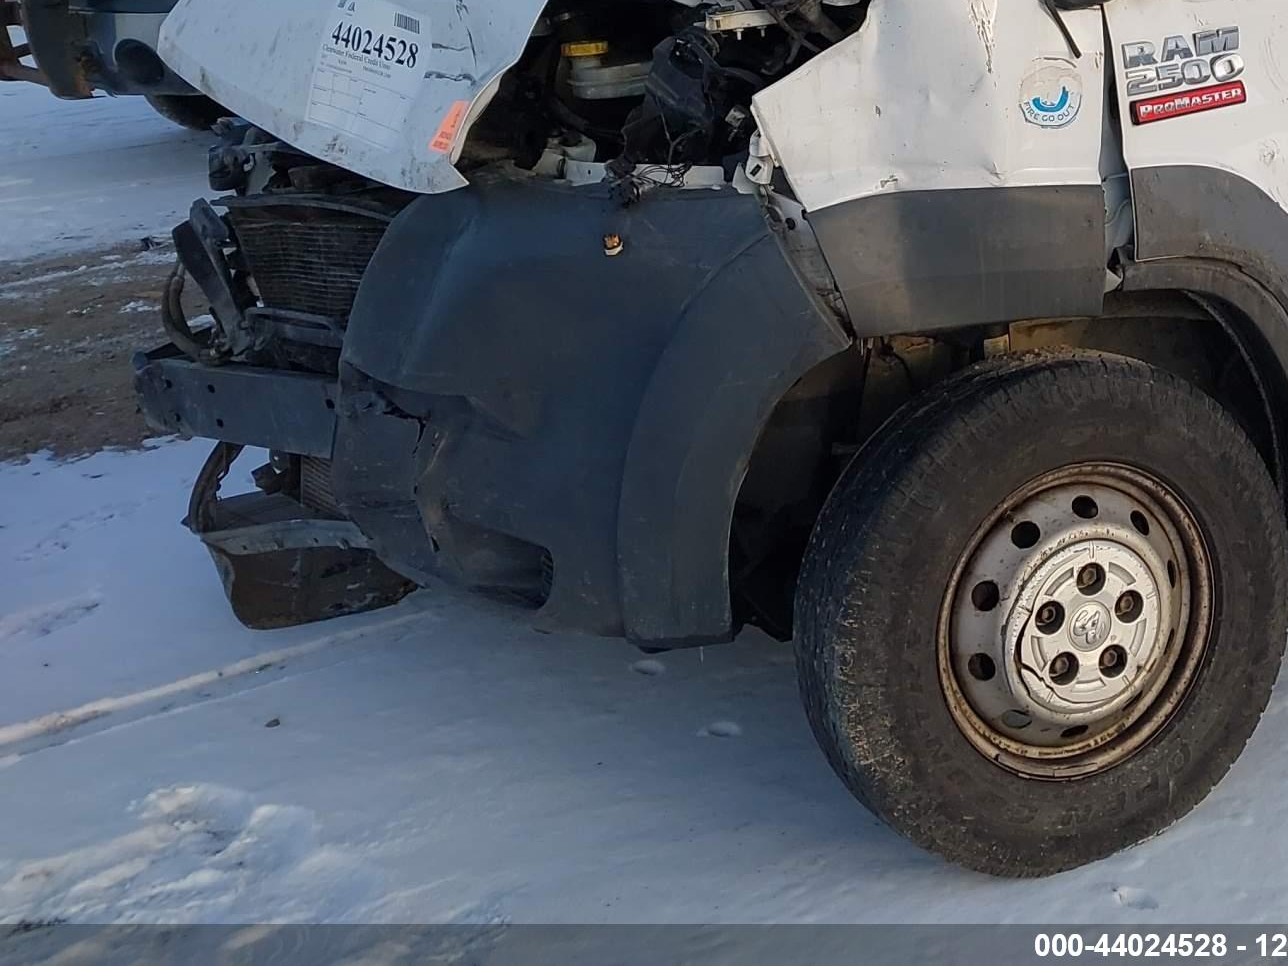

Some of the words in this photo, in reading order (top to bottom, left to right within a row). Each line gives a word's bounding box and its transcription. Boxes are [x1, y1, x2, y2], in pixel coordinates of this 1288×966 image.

[332, 21, 418, 68] 44024528
[1120, 26, 1239, 69] RAM
[1125, 53, 1245, 97] 2500
